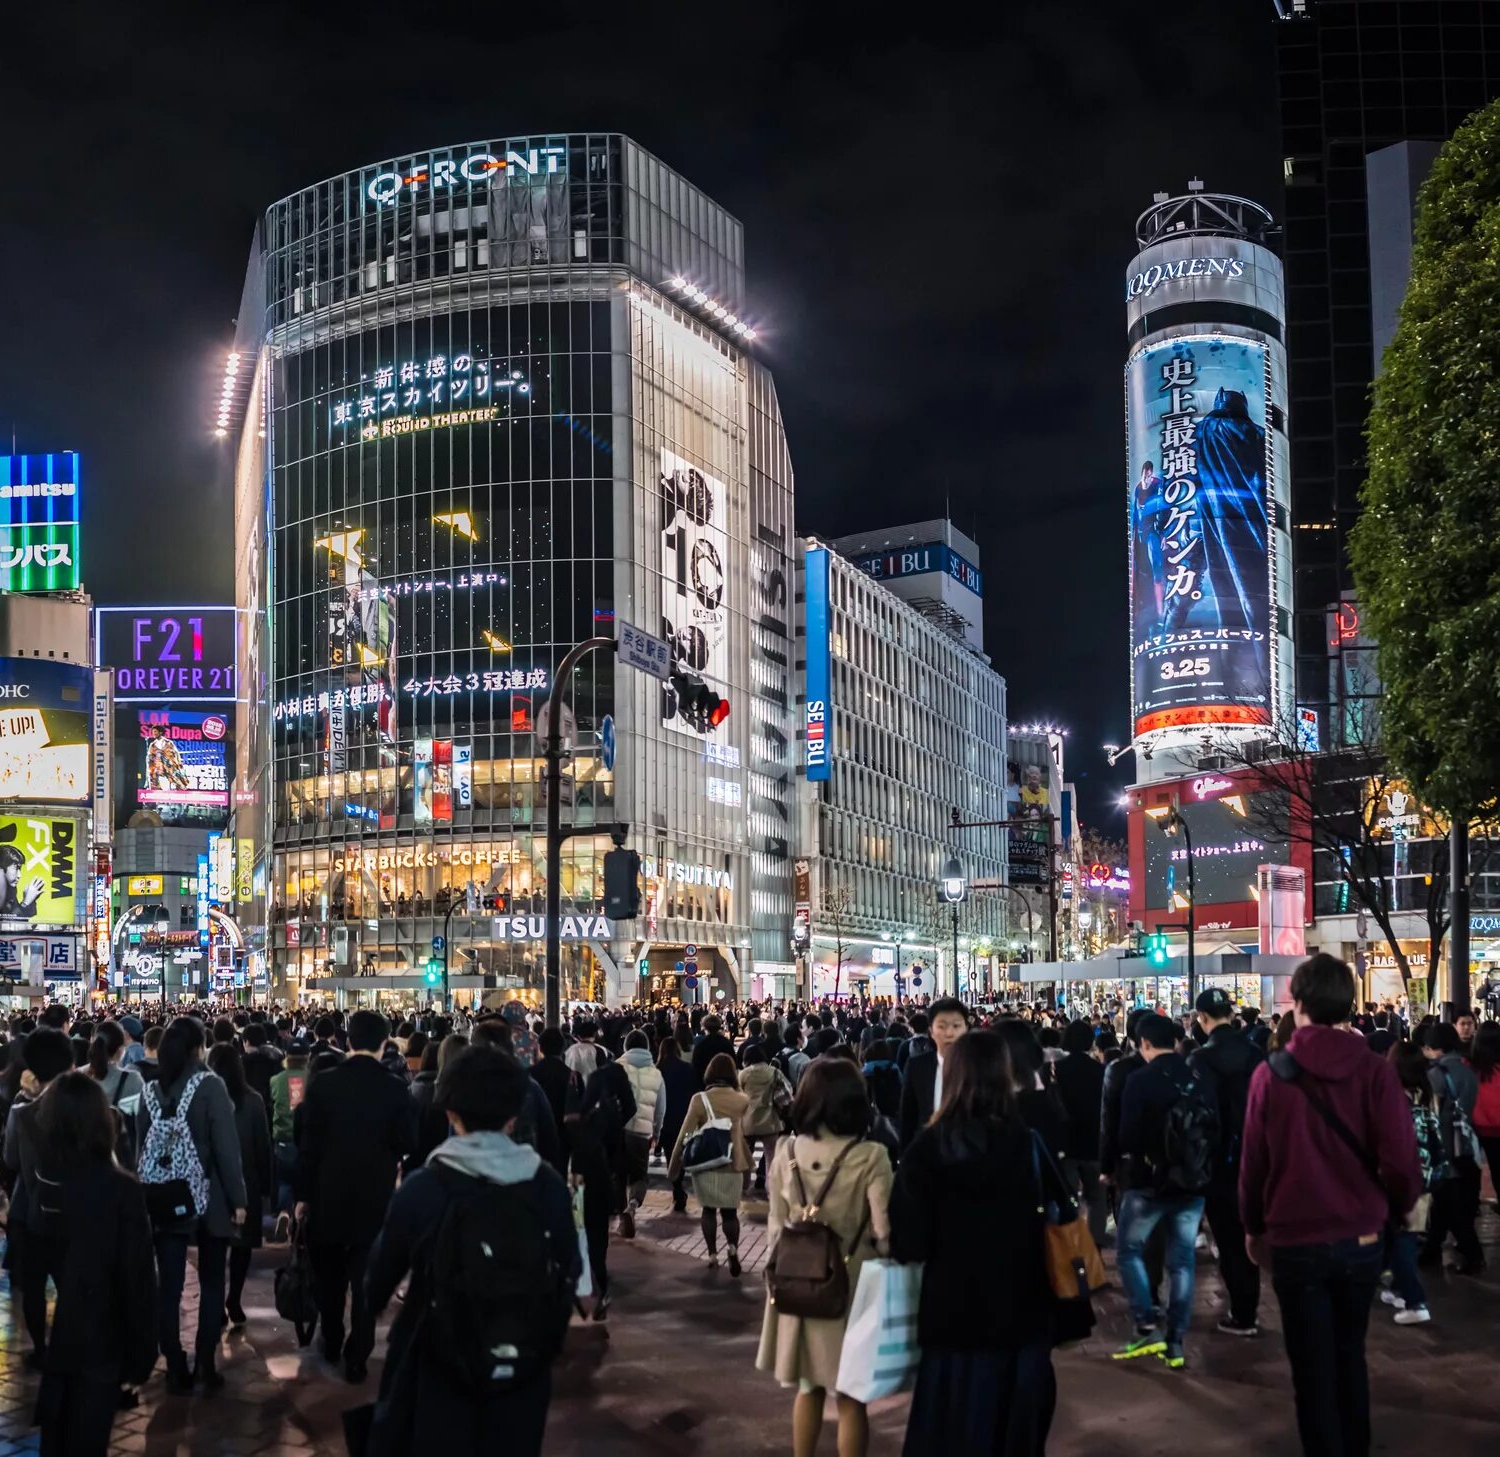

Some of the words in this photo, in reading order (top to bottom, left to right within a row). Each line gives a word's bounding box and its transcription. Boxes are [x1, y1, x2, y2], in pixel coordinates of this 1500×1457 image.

[333, 370, 530, 425] 東京スカイツリー。
[1160, 358, 1201, 601] 史上最強のケンカ。
[133, 618, 203, 661] F21
[623, 628, 667, 665] 渋谷駅前
[210, 668, 232, 690] 21
[1161, 657, 1211, 680] 3.25
[10, 715, 36, 735] UP!
[806, 700, 826, 767] SEIBU
[26, 819, 50, 872] FX
[51, 821, 74, 899] DMM
[334, 851, 438, 873] STARBUCKS
[447, 849, 521, 866] COFFEE
[1171, 841, 1264, 861] 天空イトショー、上演中。
